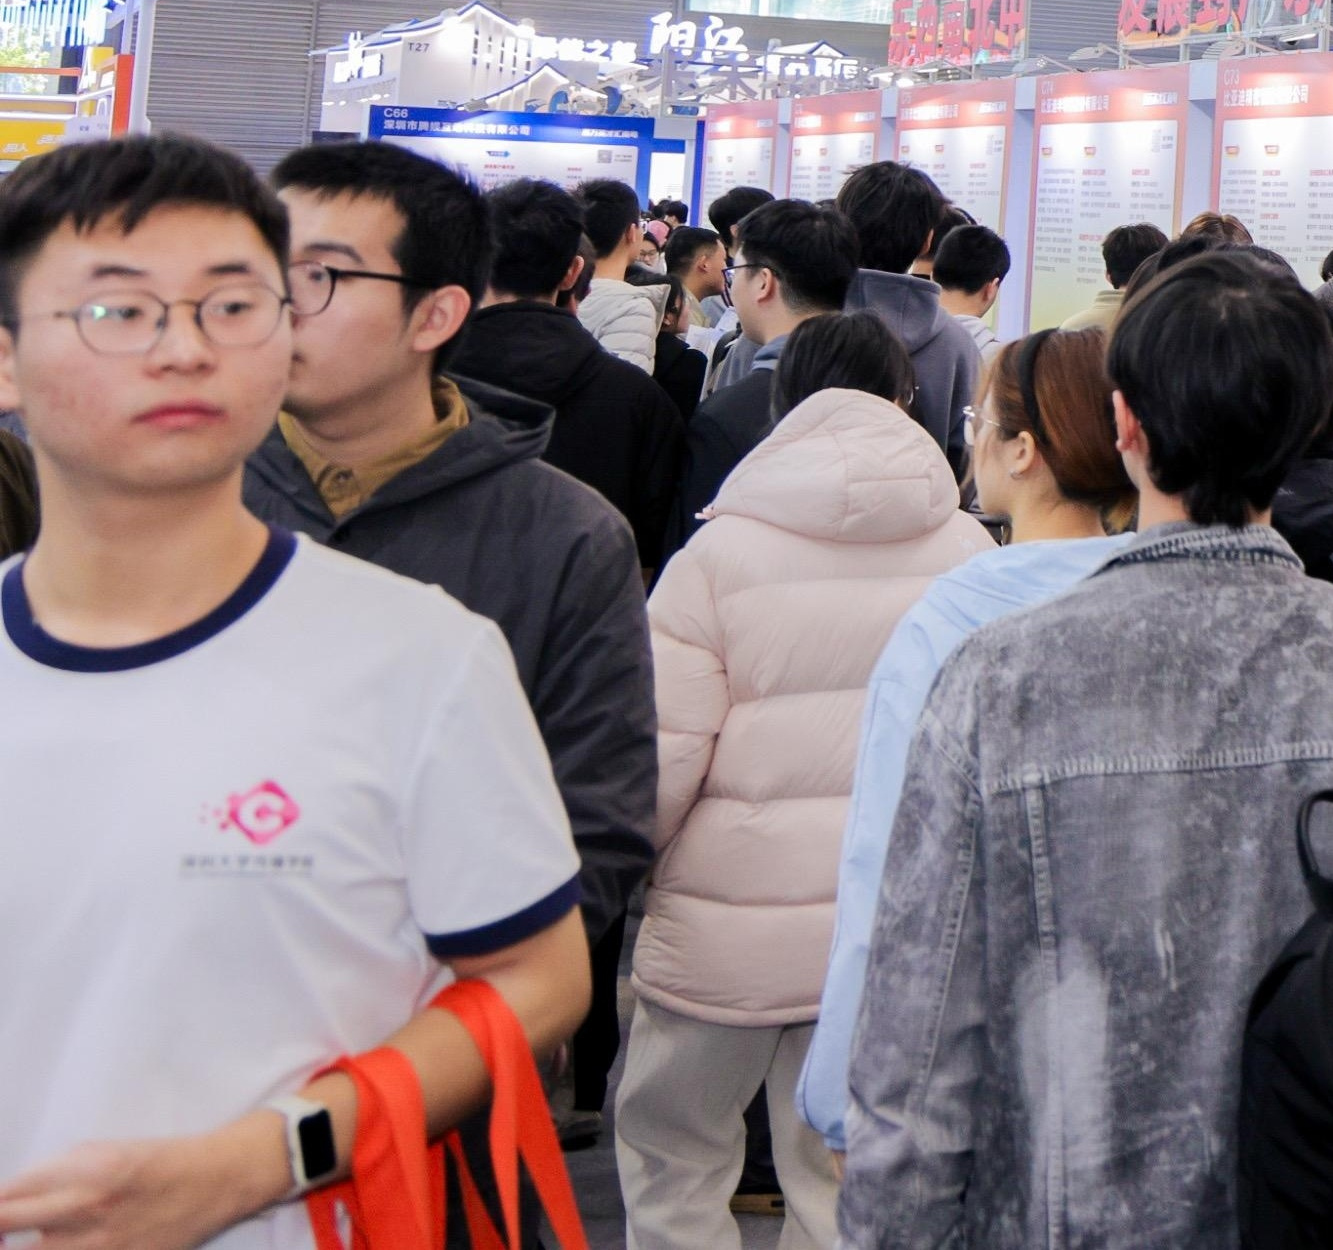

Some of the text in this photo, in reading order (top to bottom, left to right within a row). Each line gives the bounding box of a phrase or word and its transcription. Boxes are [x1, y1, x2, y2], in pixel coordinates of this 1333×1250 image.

[650, 12, 748, 61] 阳江
[408, 42, 430, 52] T27
[1223, 68, 1240, 84] C73
[384, 108, 408, 118] C66
